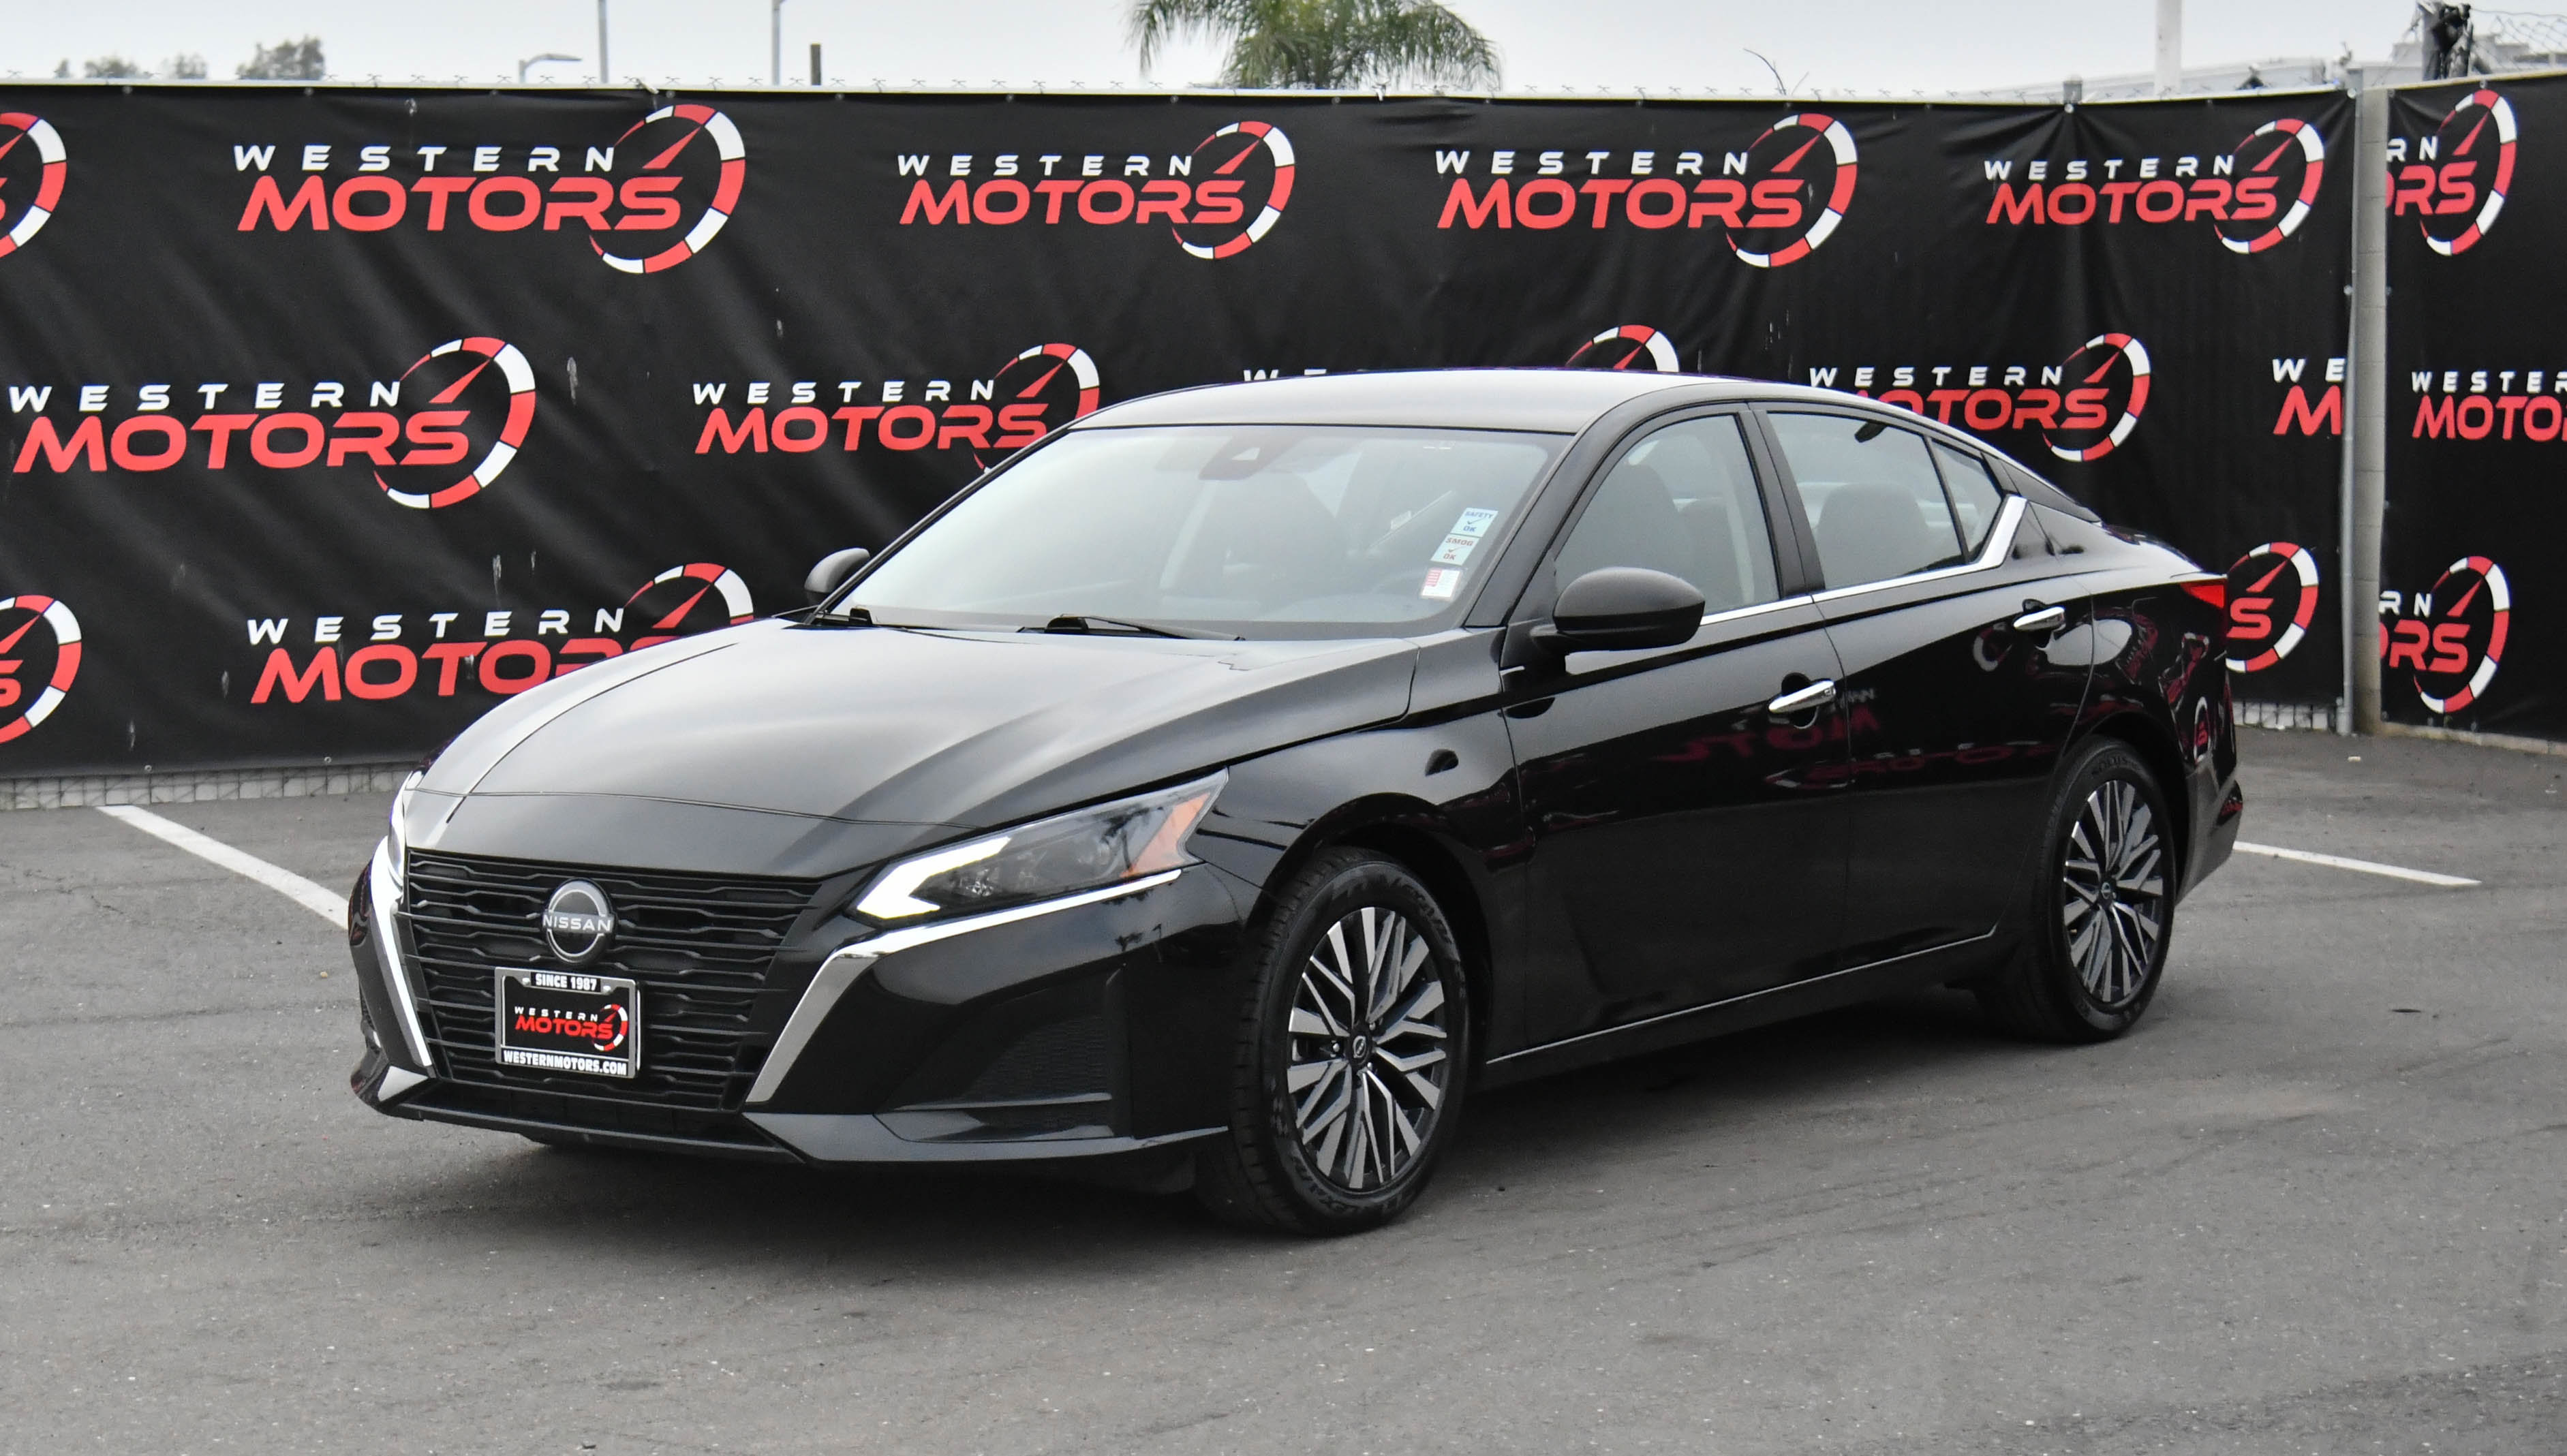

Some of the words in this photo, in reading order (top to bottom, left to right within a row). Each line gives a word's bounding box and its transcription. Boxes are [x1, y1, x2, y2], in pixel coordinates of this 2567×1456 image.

[234, 145, 615, 172] WESTERN
[897, 155, 1192, 176] WESTERN
[1435, 151, 1748, 175] WESTERN
[1984, 154, 2234, 181] WESTERN
[237, 174, 683, 232] MOTORS
[900, 179, 1246, 225] MOTORS
[1437, 178, 1805, 229] MOTORS
[1986, 177, 2279, 226] MOTORS
[1809, 366, 2063, 388] WESTERN
[9, 381, 401, 413] WESTERN
[692, 380, 995, 405] WESTERN
[695, 403, 1049, 454] MOTORS
[2412, 394, 2567, 442] MOTO
[13, 411, 470, 473] MOTORS
[1464, 511, 1494, 519] SAFETY
[1445, 537, 1474, 546] SMOG
[1463, 525, 1477, 533] OK
[247, 608, 624, 645] WESTERN
[542, 914, 611, 932] NISSAN
[535, 973, 568, 989] SINCE
[570, 976, 598, 991] 1987
[514, 1006, 598, 1022] WESTERN
[515, 1015, 613, 1040] MOTORS
[503, 1050, 627, 1075] WESTERNMOTORS.COM
